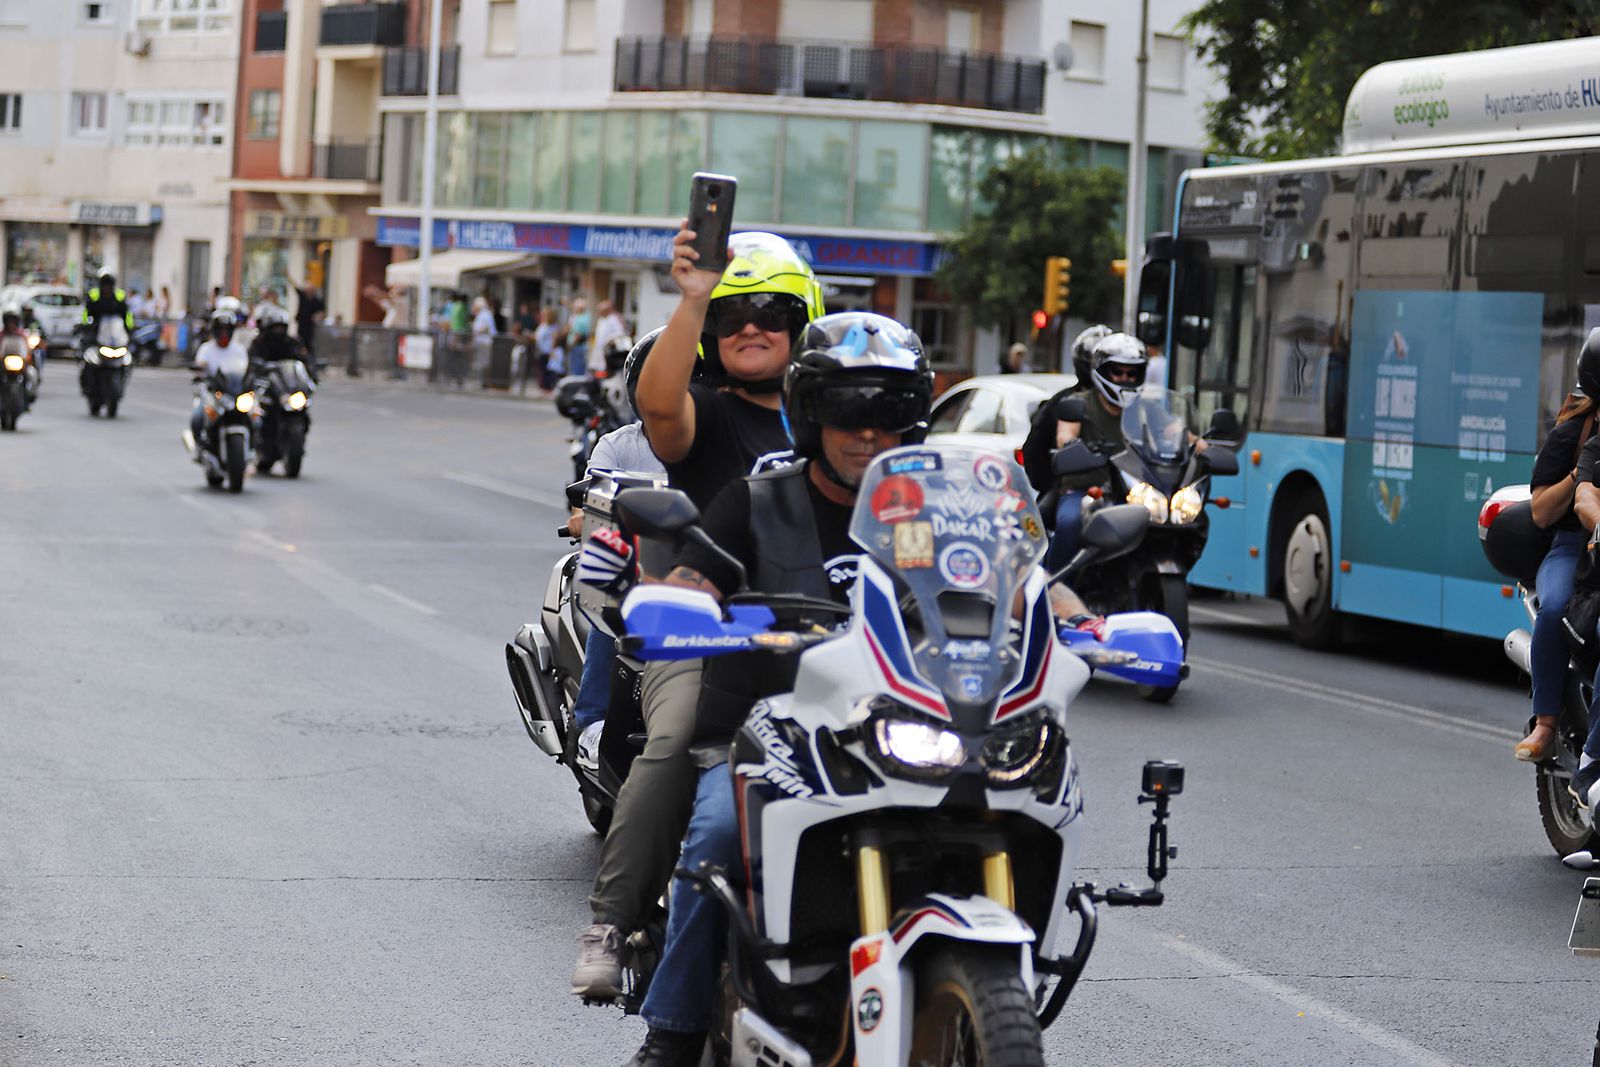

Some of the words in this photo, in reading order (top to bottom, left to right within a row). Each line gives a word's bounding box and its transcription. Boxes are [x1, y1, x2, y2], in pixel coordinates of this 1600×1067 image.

[1484, 88, 1562, 121] Ayuntamiento
[1564, 83, 1580, 108] de
[817, 242, 920, 267] GRANDE
